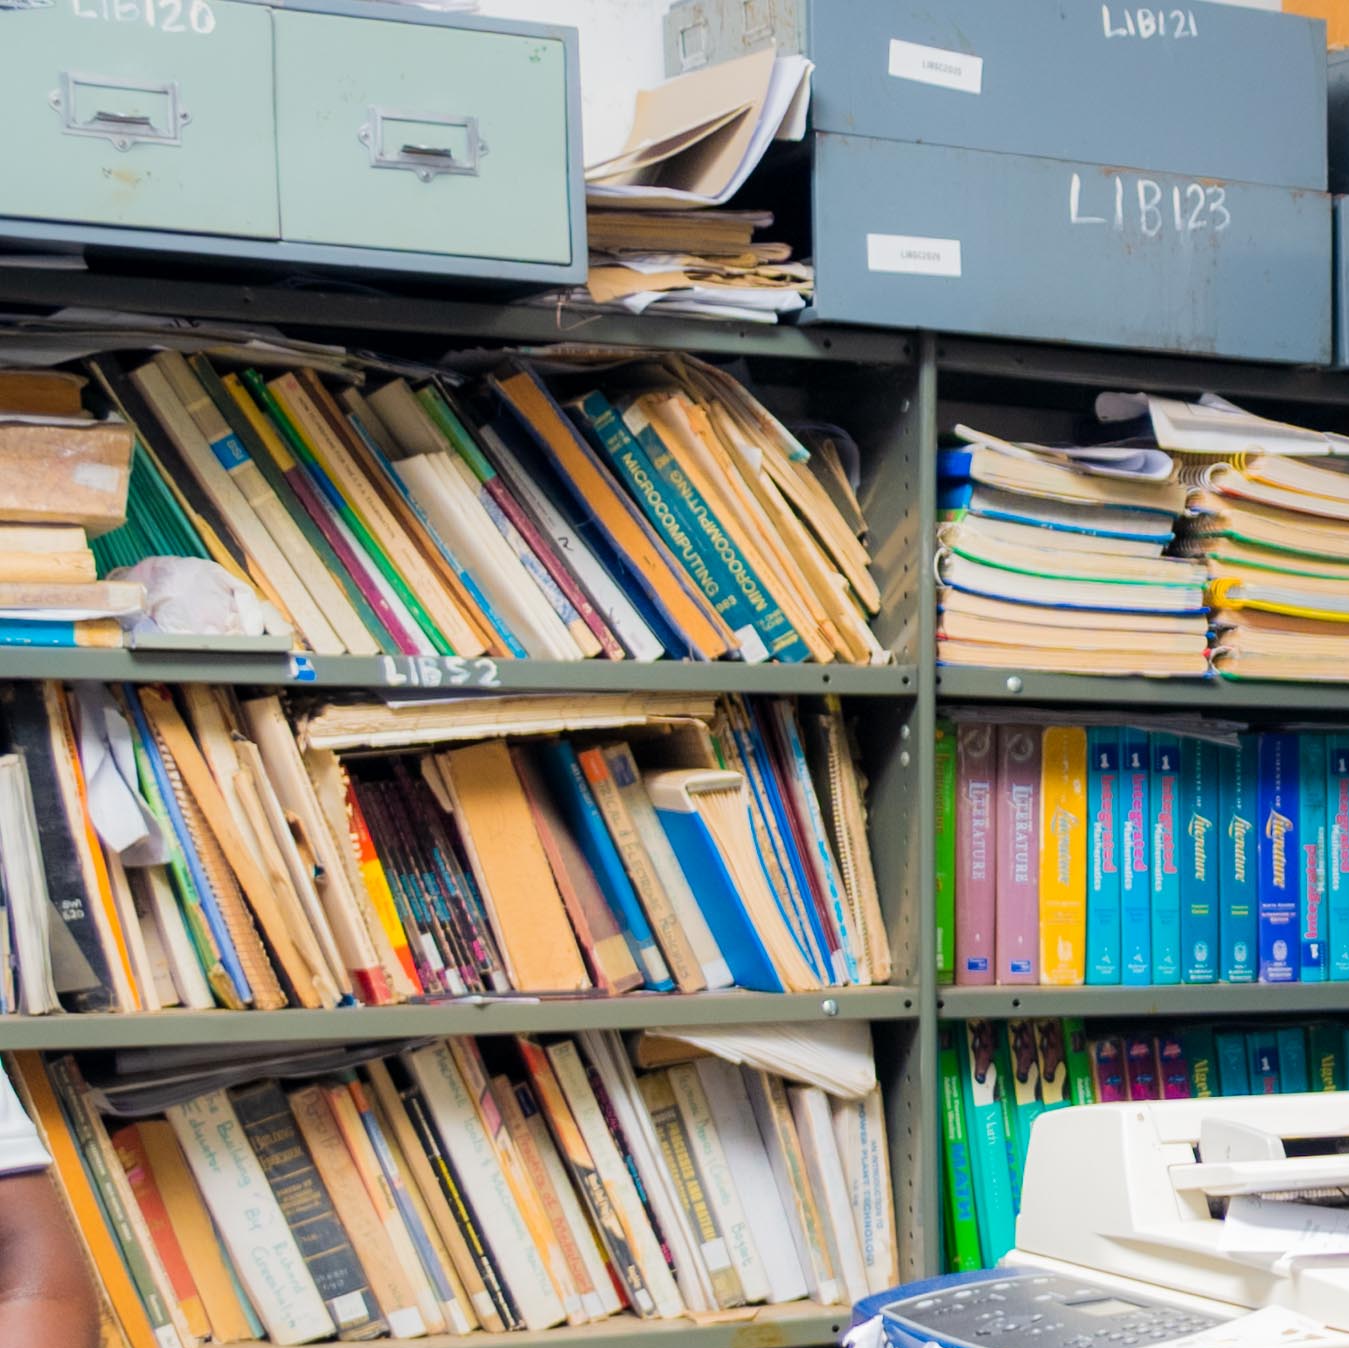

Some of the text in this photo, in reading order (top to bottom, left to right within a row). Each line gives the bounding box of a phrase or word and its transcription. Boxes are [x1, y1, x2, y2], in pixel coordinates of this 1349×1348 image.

[1102, 4, 1199, 39] LIB121
[1069, 173, 1231, 237] LIB123
[621, 451, 720, 597] MICROCOMPUTING
[669, 462, 769, 613] MICROCOMPUTING
[1100, 752, 1110, 769] 1
[1131, 752, 1141, 768] 1
[1161, 755, 1171, 770] 1
[1338, 757, 1347, 772] 1
[968, 779, 991, 881] LITERATURE
[1011, 783, 1035, 884] LITERATURE
[1097, 774, 1118, 873] Integrated
[1128, 774, 1148, 872] Integrated
[1158, 775, 1178, 874] Integrated
[1188, 812, 1213, 882] Literature
[1228, 814, 1252, 883] Literature
[1266, 806, 1294, 890] Literature
[1304, 844, 1321, 939] Integrated
[1261, 1056, 1270, 1071] 1
[951, 1142, 973, 1222] MATH
